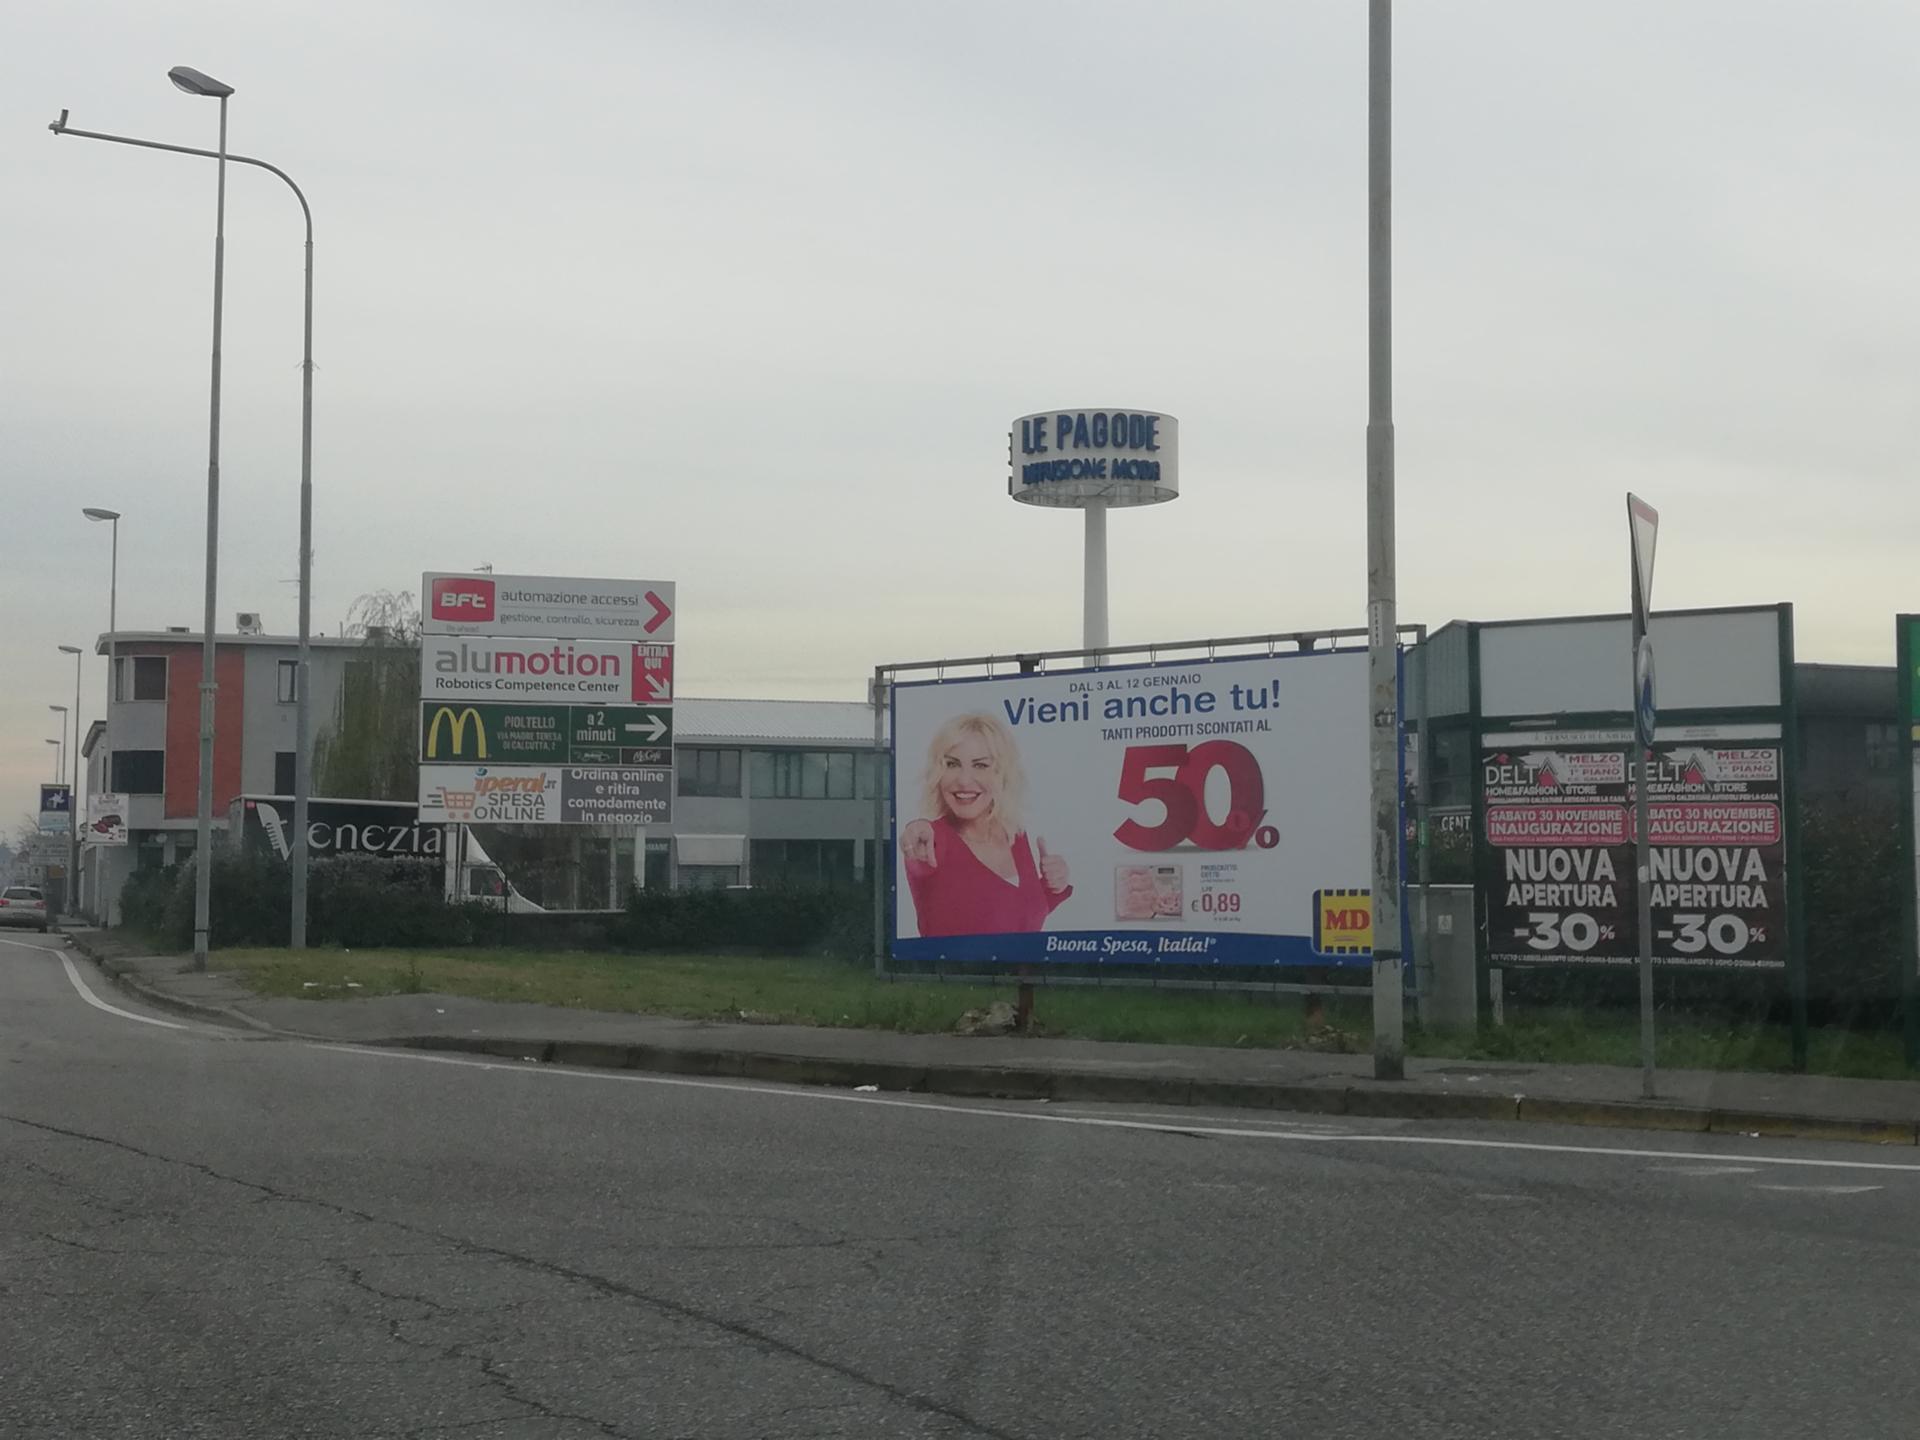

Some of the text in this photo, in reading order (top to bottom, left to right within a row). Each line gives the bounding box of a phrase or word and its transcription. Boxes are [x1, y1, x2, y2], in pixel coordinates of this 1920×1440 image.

[1022, 413, 1160, 454] LE PAGODE
[501, 590, 639, 606] automazione accessi
[500, 612, 640, 627] gestione, controllo, sicurezza
[435, 644, 620, 677] alumotion
[644, 658, 662, 669] QUI
[435, 677, 620, 693] Robotics Competence Center
[1069, 674, 1202, 693] DAL 3 AL 12 GENNAIO
[1004, 680, 1280, 726] Vieni anche tu!
[504, 716, 556, 729] PIOLTELLO
[587, 711, 605, 726] a 2
[577, 728, 617, 742] minuti
[1101, 719, 1273, 741] TANTI PRODOTTI SCONTATI AL
[1568, 754, 1621, 764] MELZO
[1717, 750, 1772, 760] MELZO
[571, 768, 664, 782] Ordina online
[1583, 767, 1621, 776] PIANO
[595, 783, 640, 795] e ritira
[1486, 784, 1597, 796] HOME&FASHION STORE
[1714, 782, 1748, 793] STORE
[488, 793, 546, 807] SPESA
[568, 797, 667, 810] comodamente
[474, 807, 545, 821] ONLINE
[598, 811, 653, 824] negozio
[1491, 809, 1623, 821] SABATO 30 NOVEMBRE
[1685, 808, 1699, 819] 30
[1703, 808, 1775, 819] NOVEMBRE
[1491, 823, 1623, 835] INAUGURAZIONE
[1506, 848, 1617, 881] NUOVA
[1649, 848, 1767, 882] NUOVA
[1505, 883, 1618, 907] APERTURA
[1649, 884, 1769, 908] APERTURA
[1191, 893, 1241, 915] € 0,89
[1324, 909, 1370, 931] MD
[1514, 912, 1615, 951] -30%
[1657, 913, 1766, 954] -30%
[1046, 936, 1098, 952] Buona
[1101, 937, 1153, 955] Spesa,
